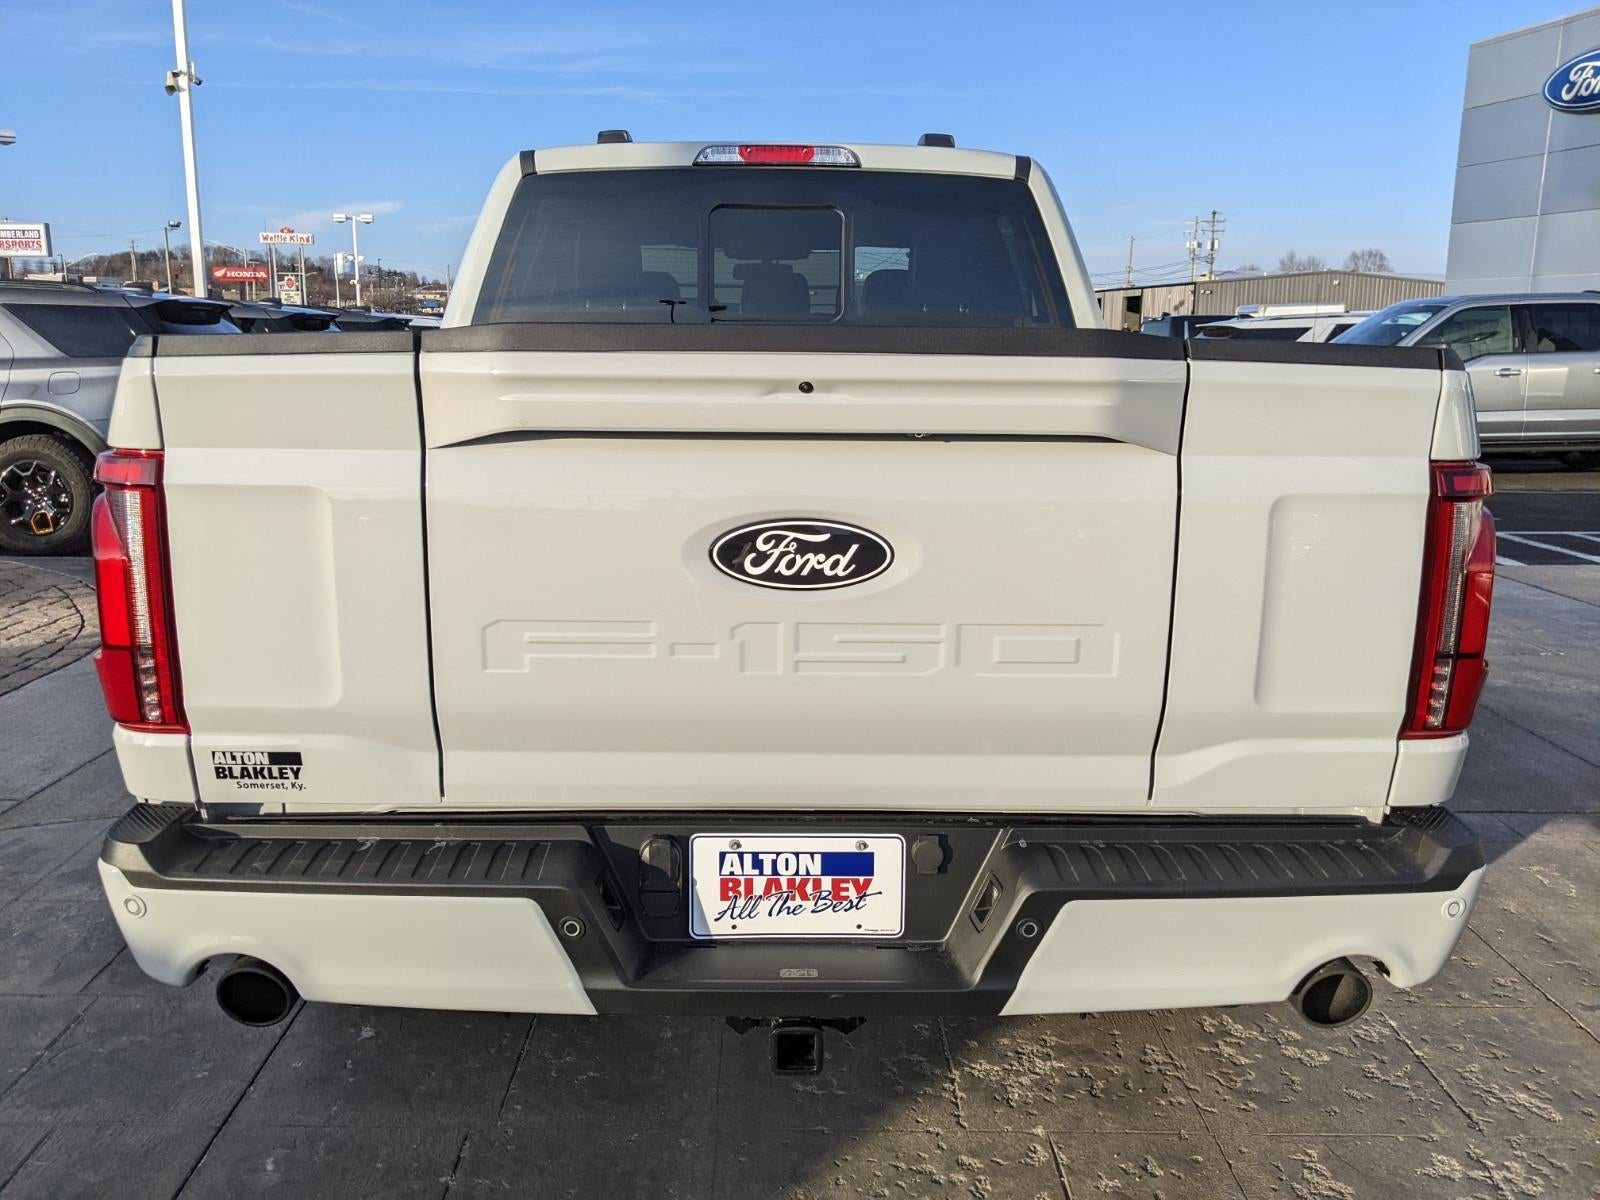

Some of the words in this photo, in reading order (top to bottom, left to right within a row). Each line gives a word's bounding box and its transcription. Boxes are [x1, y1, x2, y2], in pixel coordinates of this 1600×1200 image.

[290, 234, 311, 243] King
[744, 530, 860, 577] Ford
[480, 620, 1121, 677] F-150
[213, 751, 270, 765] ALTON
[214, 766, 302, 780] BLAKLEY
[236, 781, 289, 790] Somerset,
[291, 781, 307, 792] Ky.
[720, 852, 822, 876] ALTON
[719, 877, 874, 902] BLAKLEY
[714, 893, 762, 922] All
[765, 890, 807, 917] The
[809, 889, 883, 914] Best
